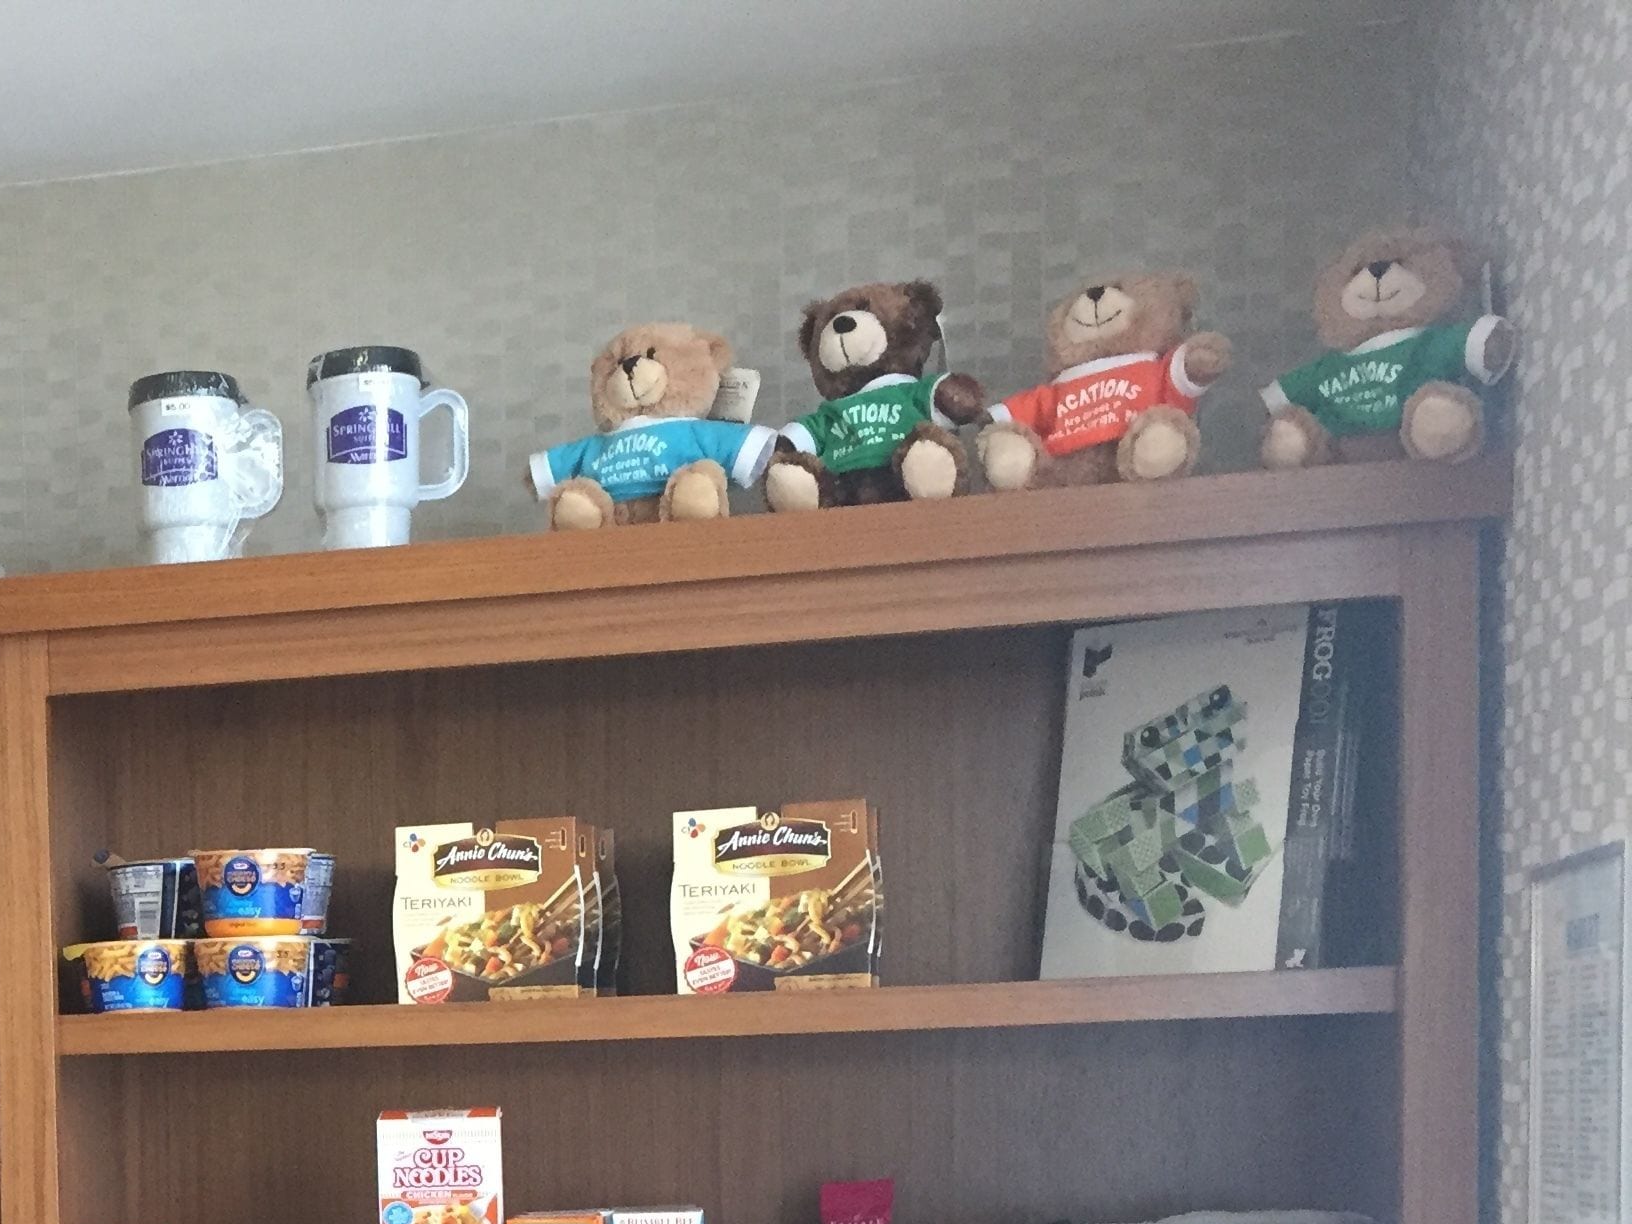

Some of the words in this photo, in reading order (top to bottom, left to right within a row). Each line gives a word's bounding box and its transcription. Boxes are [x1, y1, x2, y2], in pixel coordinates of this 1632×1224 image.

[717, 831, 770, 858] Annie
[772, 826, 828, 846] Chun's
[436, 845, 485, 871] Annie
[487, 842, 538, 862] Chun's
[781, 859, 811, 867] BOWL
[495, 873, 525, 882] BOWL
[678, 883, 756, 898] TERIYAKI
[400, 896, 472, 911] TERIYAKI
[413, 1147, 465, 1168] CUP
[393, 1165, 483, 1188] NOODLES
